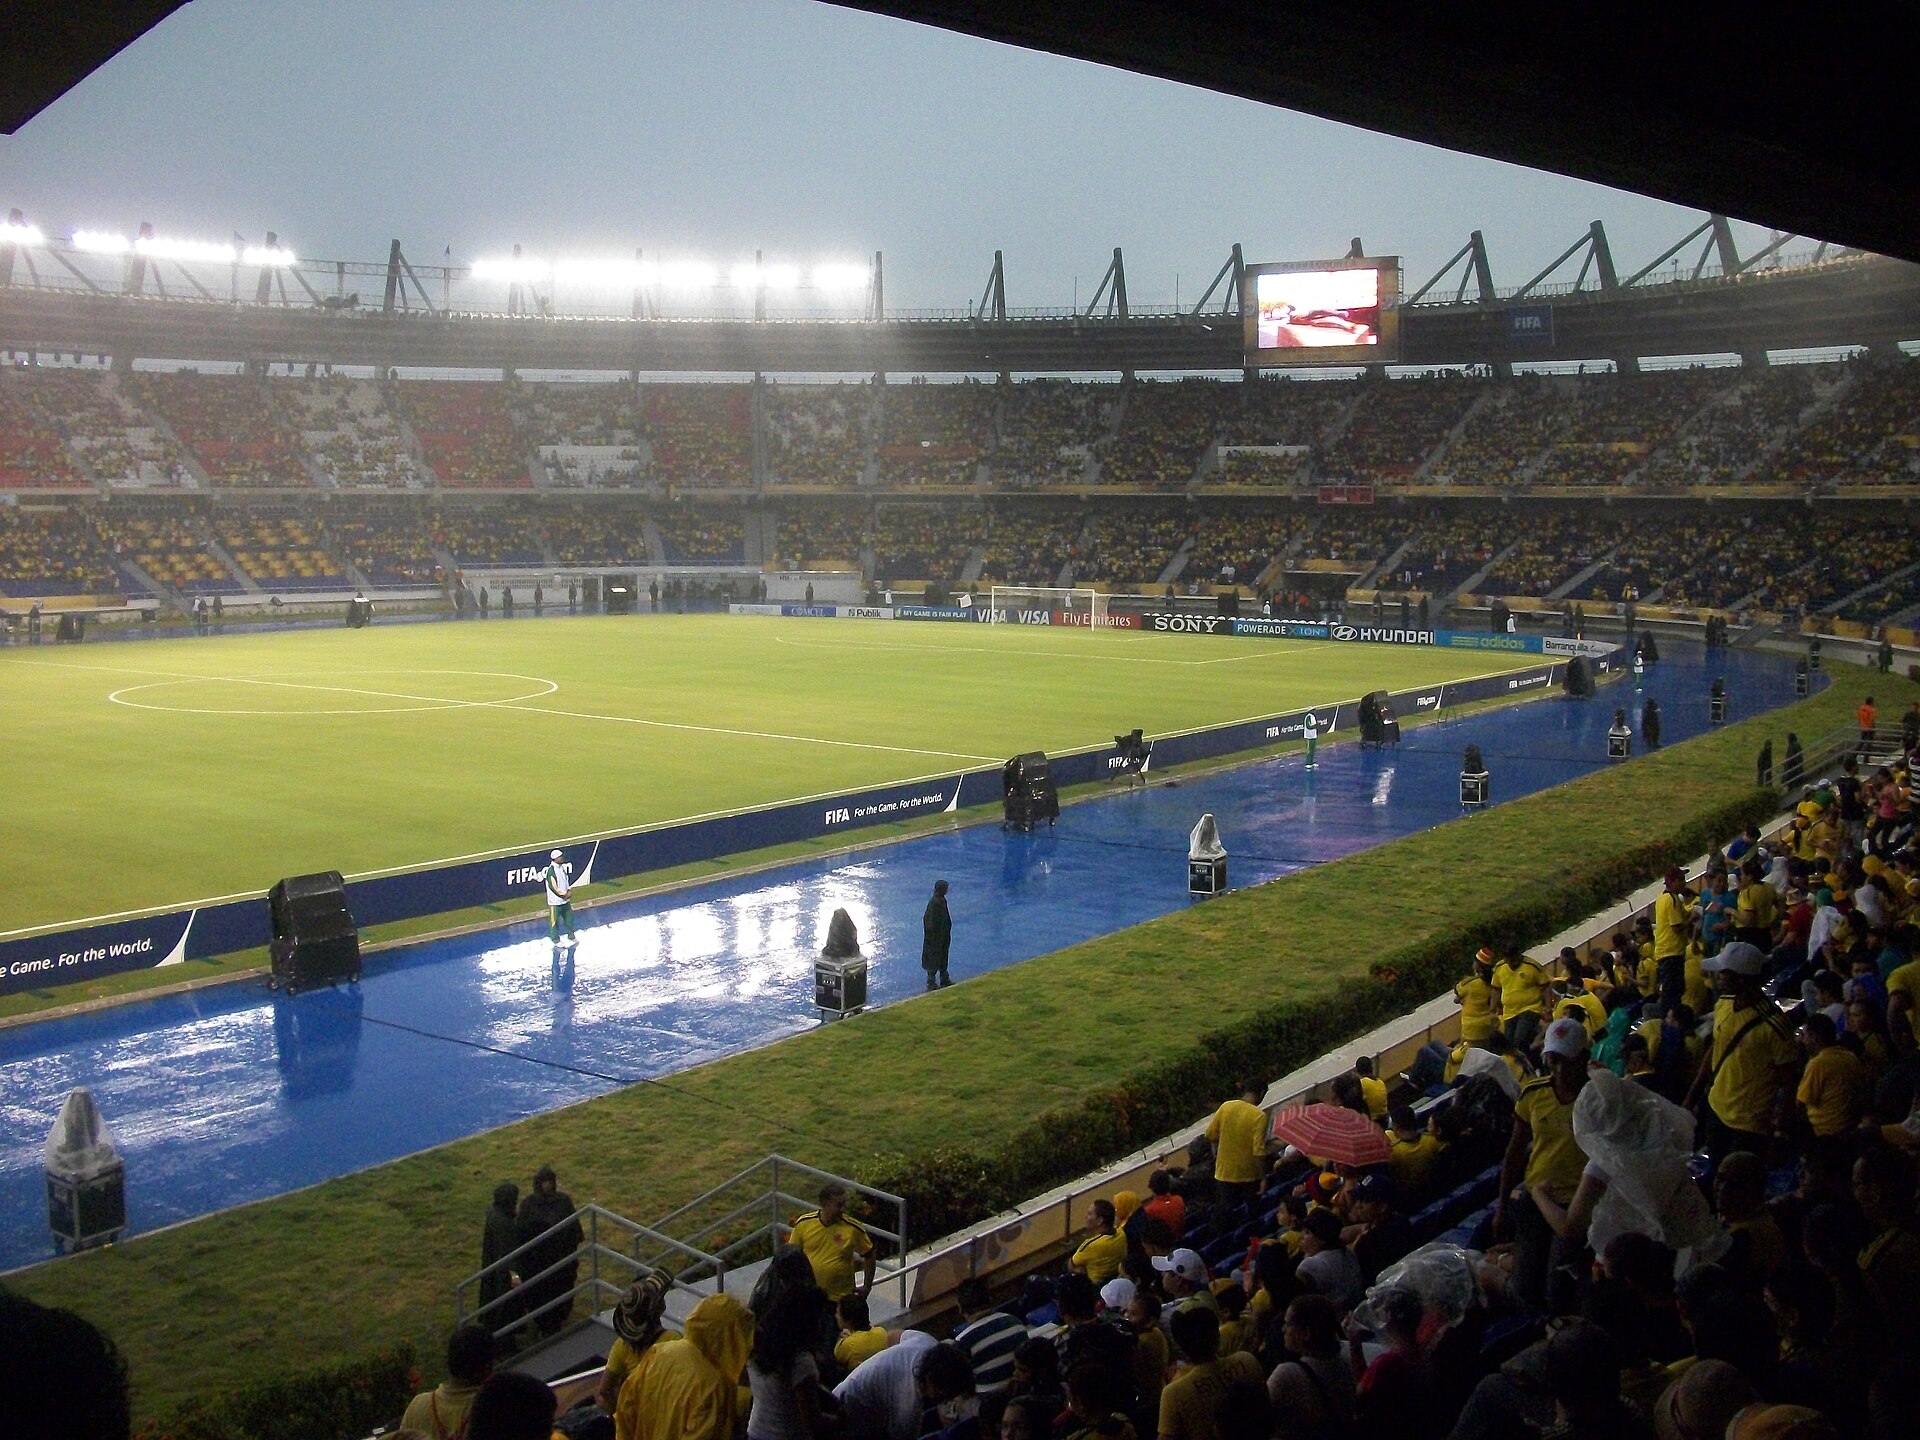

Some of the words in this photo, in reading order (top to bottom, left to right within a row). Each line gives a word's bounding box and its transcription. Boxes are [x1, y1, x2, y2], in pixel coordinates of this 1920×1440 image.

[1514, 316, 1541, 329] FIFA
[856, 608, 881, 618] Publik
[976, 608, 1007, 623] VISA
[1018, 610, 1050, 625] VISA
[1063, 612, 1081, 626] Fly
[1083, 613, 1131, 627] Emirates
[1154, 616, 1219, 633] SONY
[1237, 623, 1286, 635] POWERADE
[1360, 628, 1434, 645] HYUNDAI
[1480, 636, 1525, 650] adidas
[1545, 640, 1588, 655] Barranquilla
[1266, 726, 1280, 738] FIFA
[825, 807, 851, 825] FIFA
[854, 807, 866, 818] For
[866, 805, 878, 815] the
[878, 802, 899, 813] Game.
[899, 800, 911, 809] For
[911, 797, 922, 807] the
[922, 792, 943, 806] World.
[10, 958, 55, 976] Game.
[58, 952, 81, 967] For
[83, 947, 106, 963] the
[109, 937, 153, 957] World.
